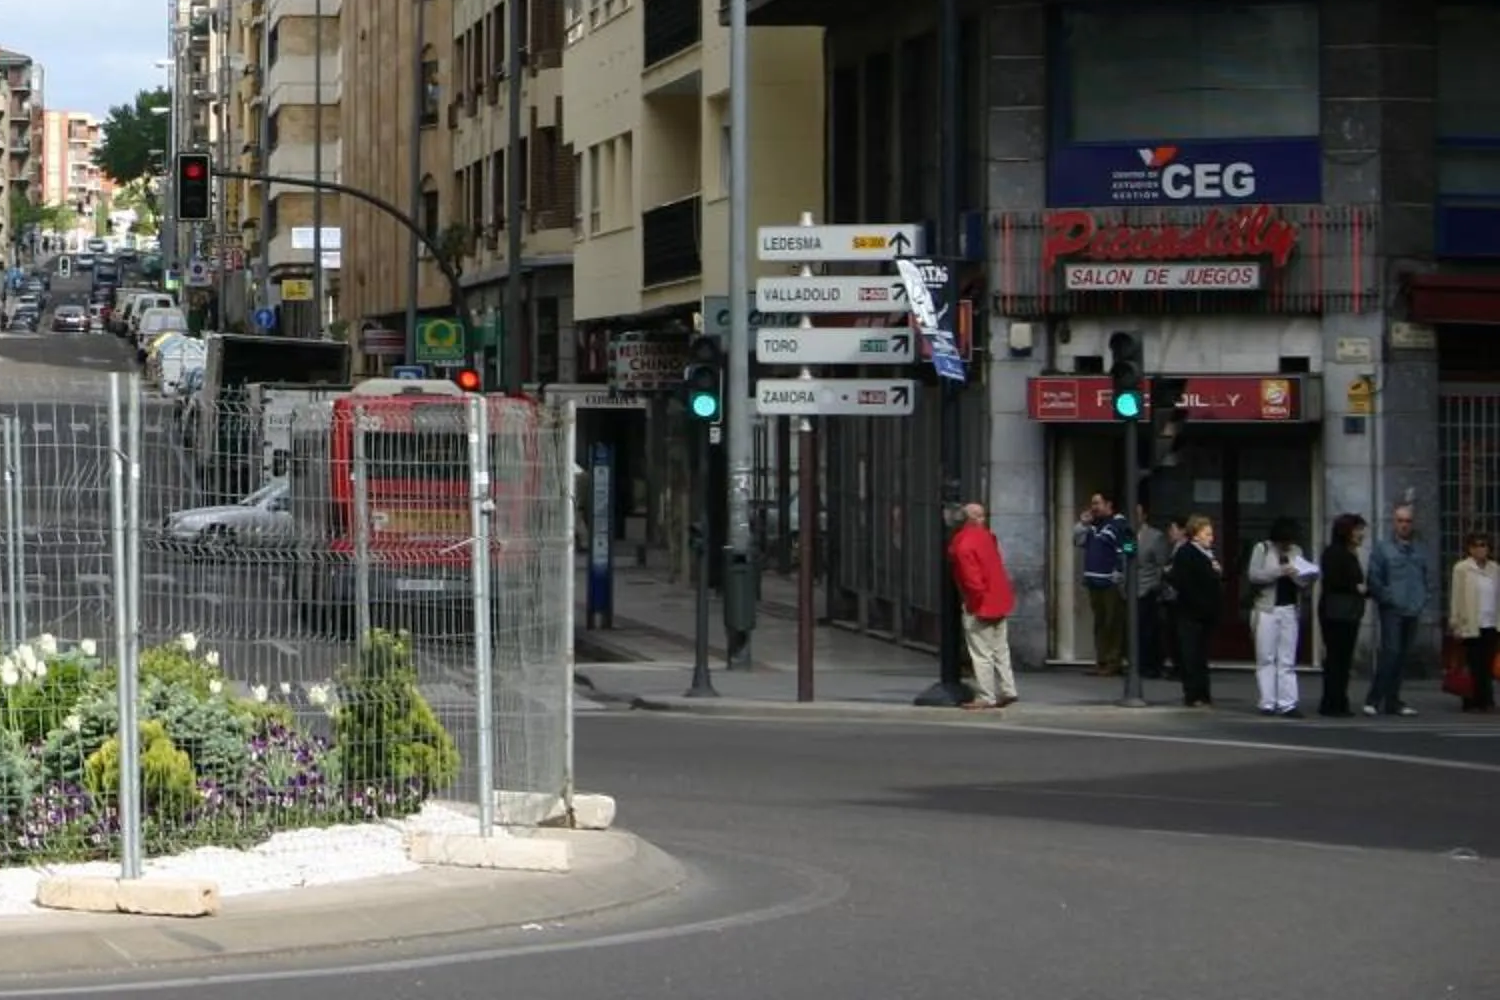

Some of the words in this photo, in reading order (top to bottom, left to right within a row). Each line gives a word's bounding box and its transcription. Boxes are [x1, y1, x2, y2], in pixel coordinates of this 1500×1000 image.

[1162, 162, 1255, 199] CEG
[763, 236, 822, 251] LEDESMA
[1144, 268, 1170, 285] DE
[1180, 267, 1253, 285] JUEGOS
[763, 287, 841, 301] VALLADOLID
[764, 339, 798, 353] TORO
[762, 391, 815, 405] ZAMORA
